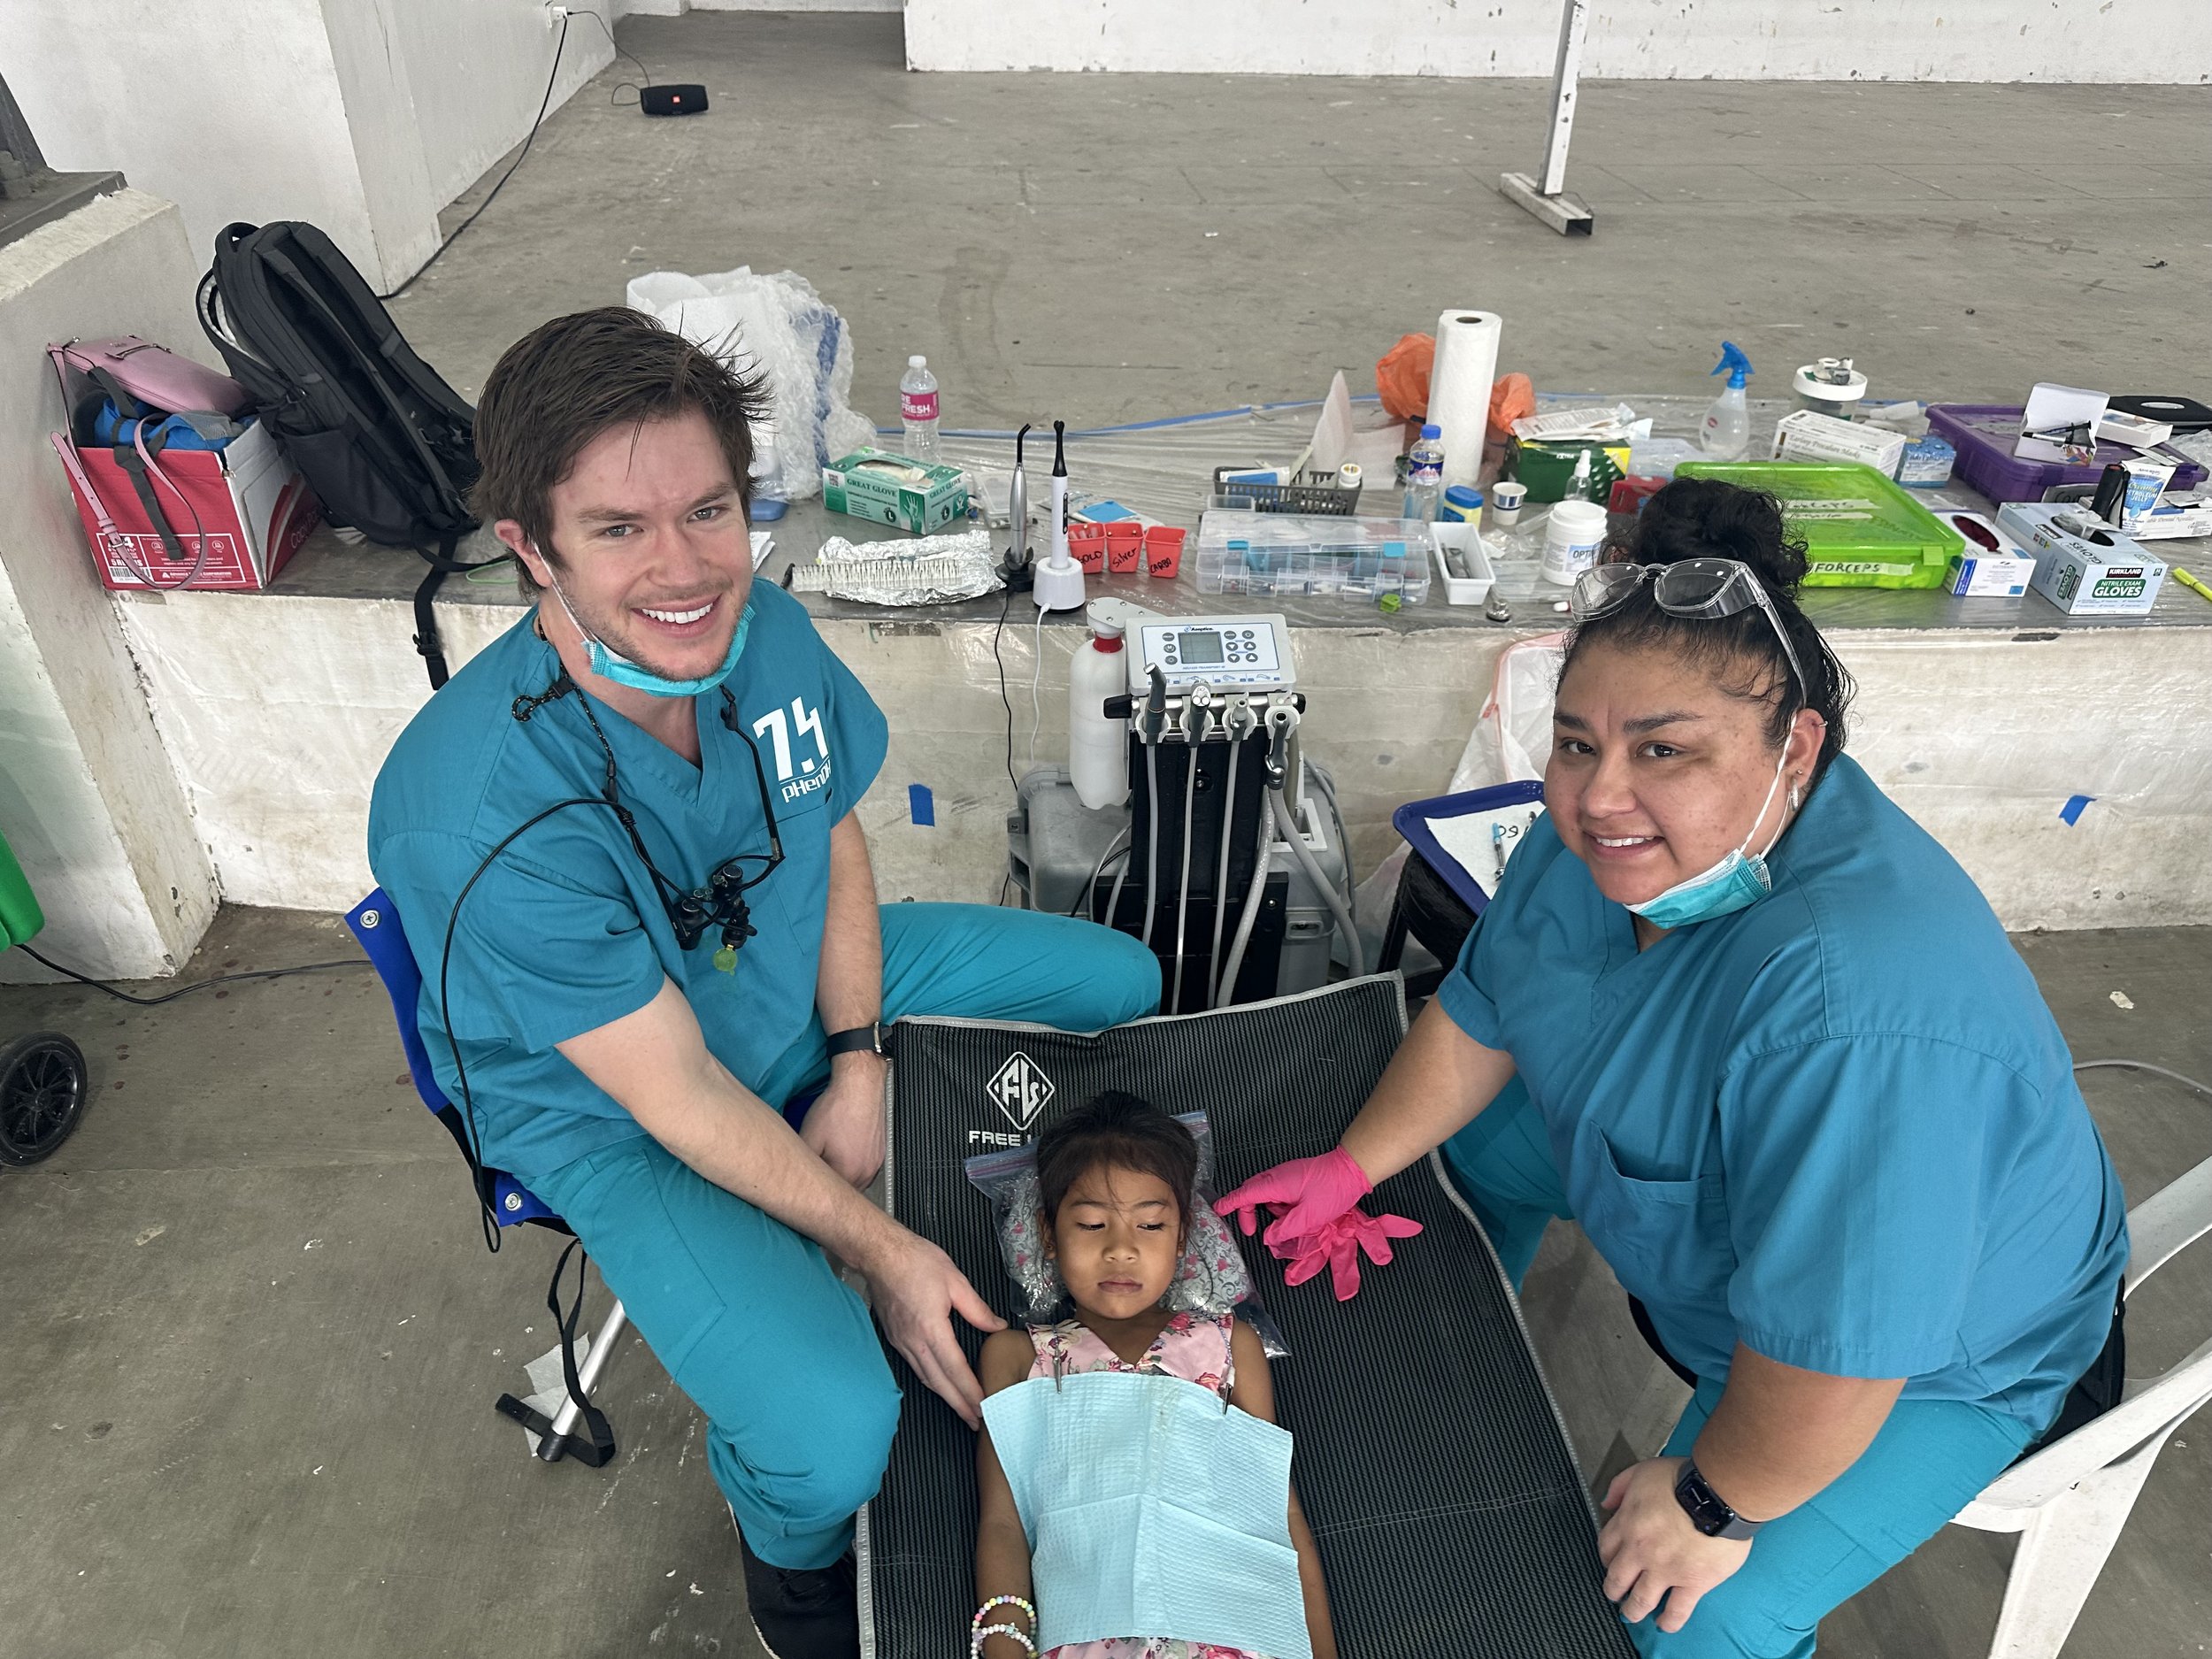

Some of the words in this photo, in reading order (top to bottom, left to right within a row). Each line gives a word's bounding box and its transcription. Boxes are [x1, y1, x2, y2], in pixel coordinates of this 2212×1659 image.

[902, 403, 930, 414] FRESH
[847, 478, 871, 491] GREAT
[872, 485, 897, 498] GLOVE
[929, 486, 946, 499] GREAT
[945, 477, 962, 491] GLOVE
[1112, 548, 1137, 568] Silver
[1149, 557, 1172, 574] CARBO
[1814, 563, 1881, 573] FORCEPS
[2057, 565, 2074, 597] GLOVES
[2093, 586, 2142, 597] GLOVES
[968, 1130, 1021, 1147] FREE
